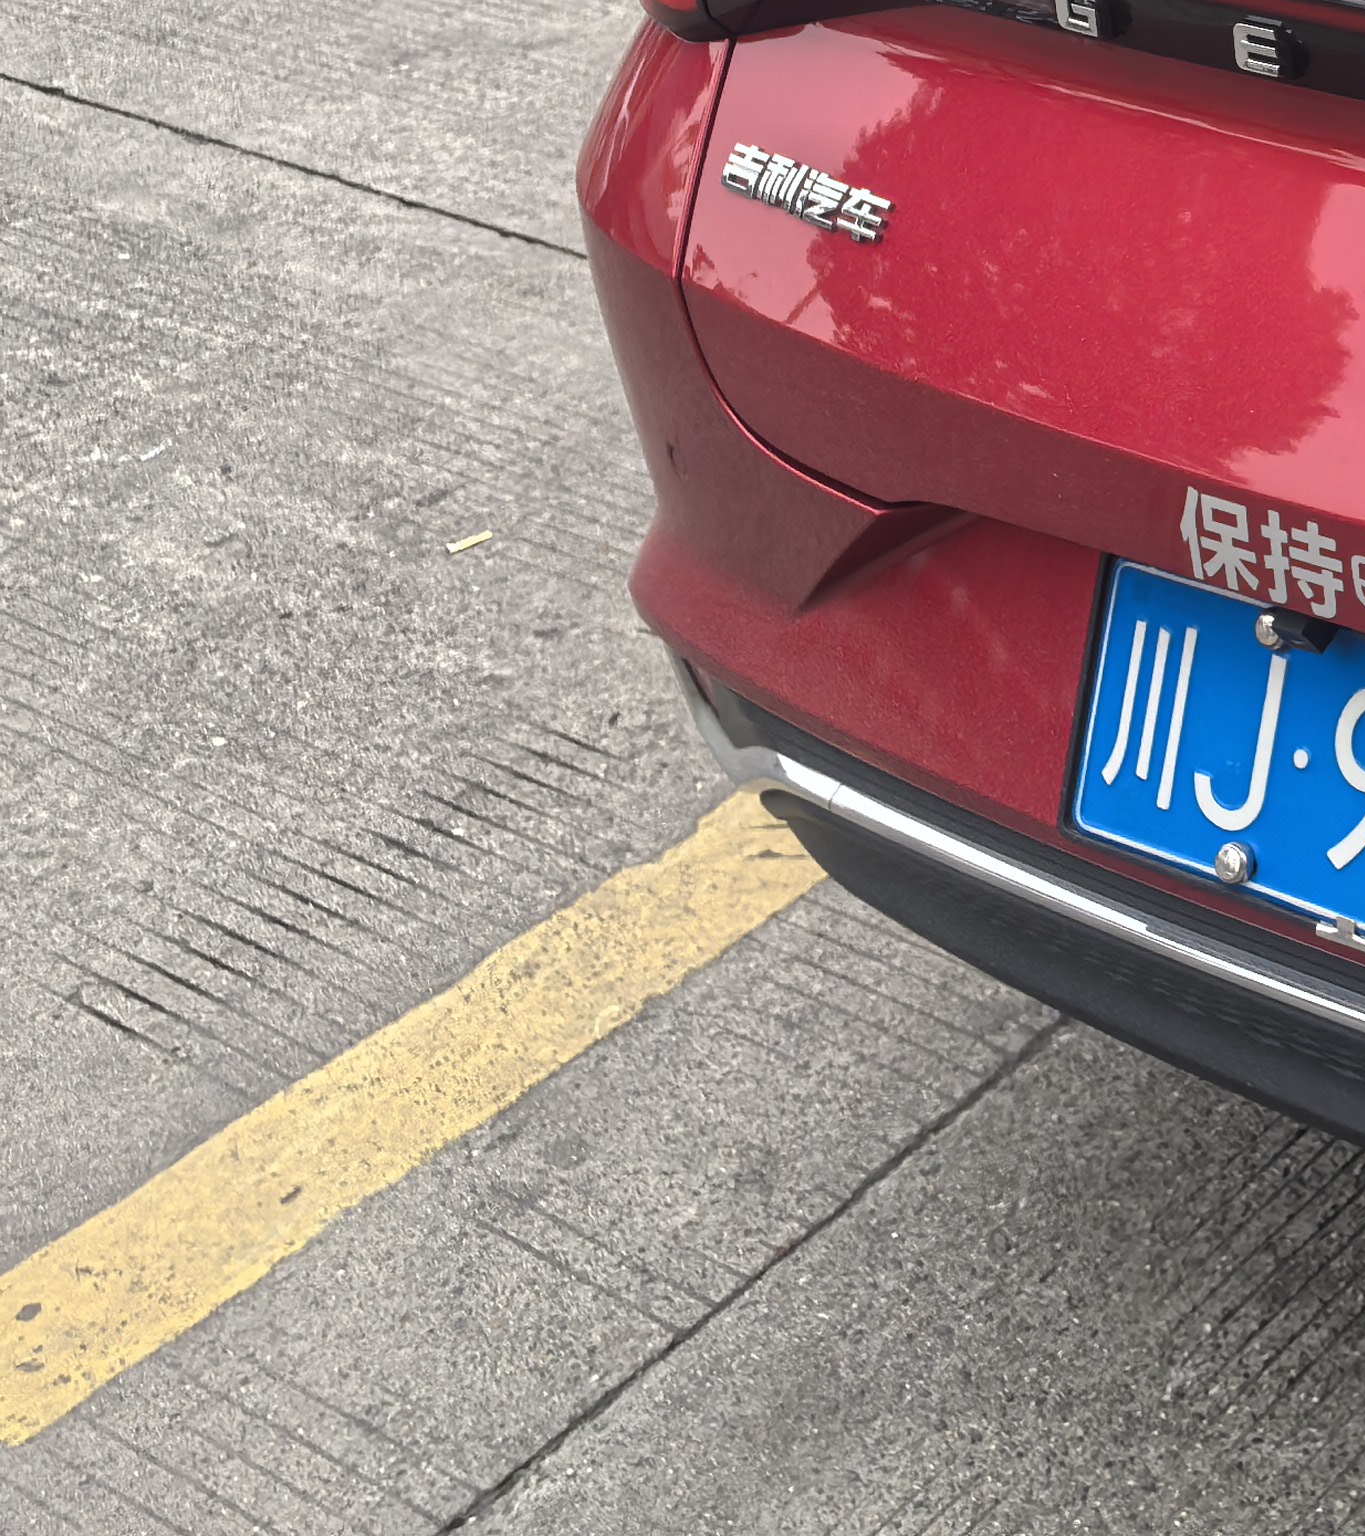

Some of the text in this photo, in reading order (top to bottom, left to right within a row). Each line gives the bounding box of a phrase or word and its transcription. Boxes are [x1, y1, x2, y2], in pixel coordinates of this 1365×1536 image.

[722, 142, 896, 244] 吉利汽车
[1180, 486, 1345, 620] 保持
